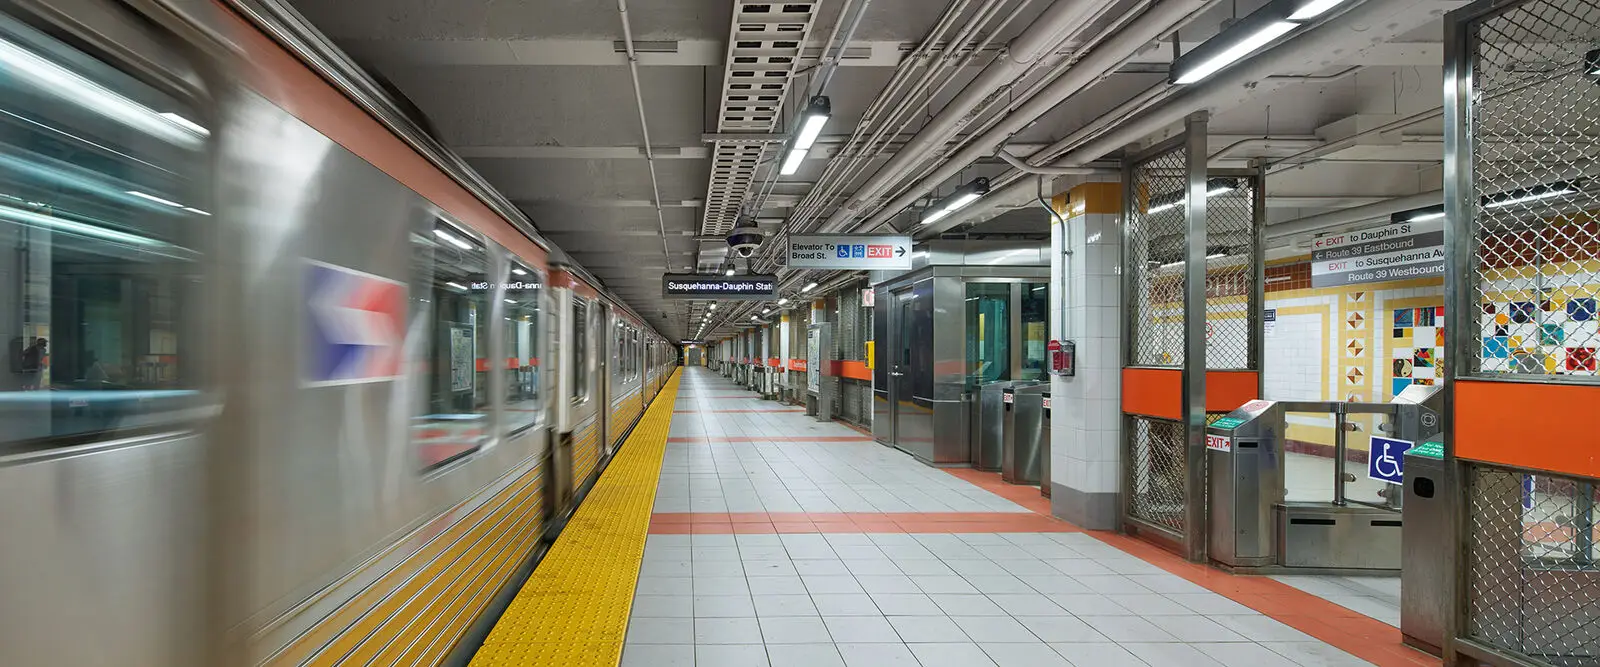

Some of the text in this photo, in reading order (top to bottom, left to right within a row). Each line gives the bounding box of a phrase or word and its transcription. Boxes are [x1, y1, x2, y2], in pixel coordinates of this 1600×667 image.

[1326, 224, 1411, 246] EXIT to Dauphin St
[792, 243, 835, 251] Elevator To
[869, 247, 891, 256] EXIT
[1325, 238, 1414, 259] Route 39 Eastbound
[792, 252, 827, 260] Broad St.
[1328, 261, 1348, 271] EXIT
[1355, 259, 1364, 268] to
[1366, 250, 1431, 266] Susquehanna
[1348, 263, 1445, 282] Route 39 Westbound
[668, 281, 754, 291] Susquehanna-Dauphin
[1206, 435, 1224, 449] EXIT
